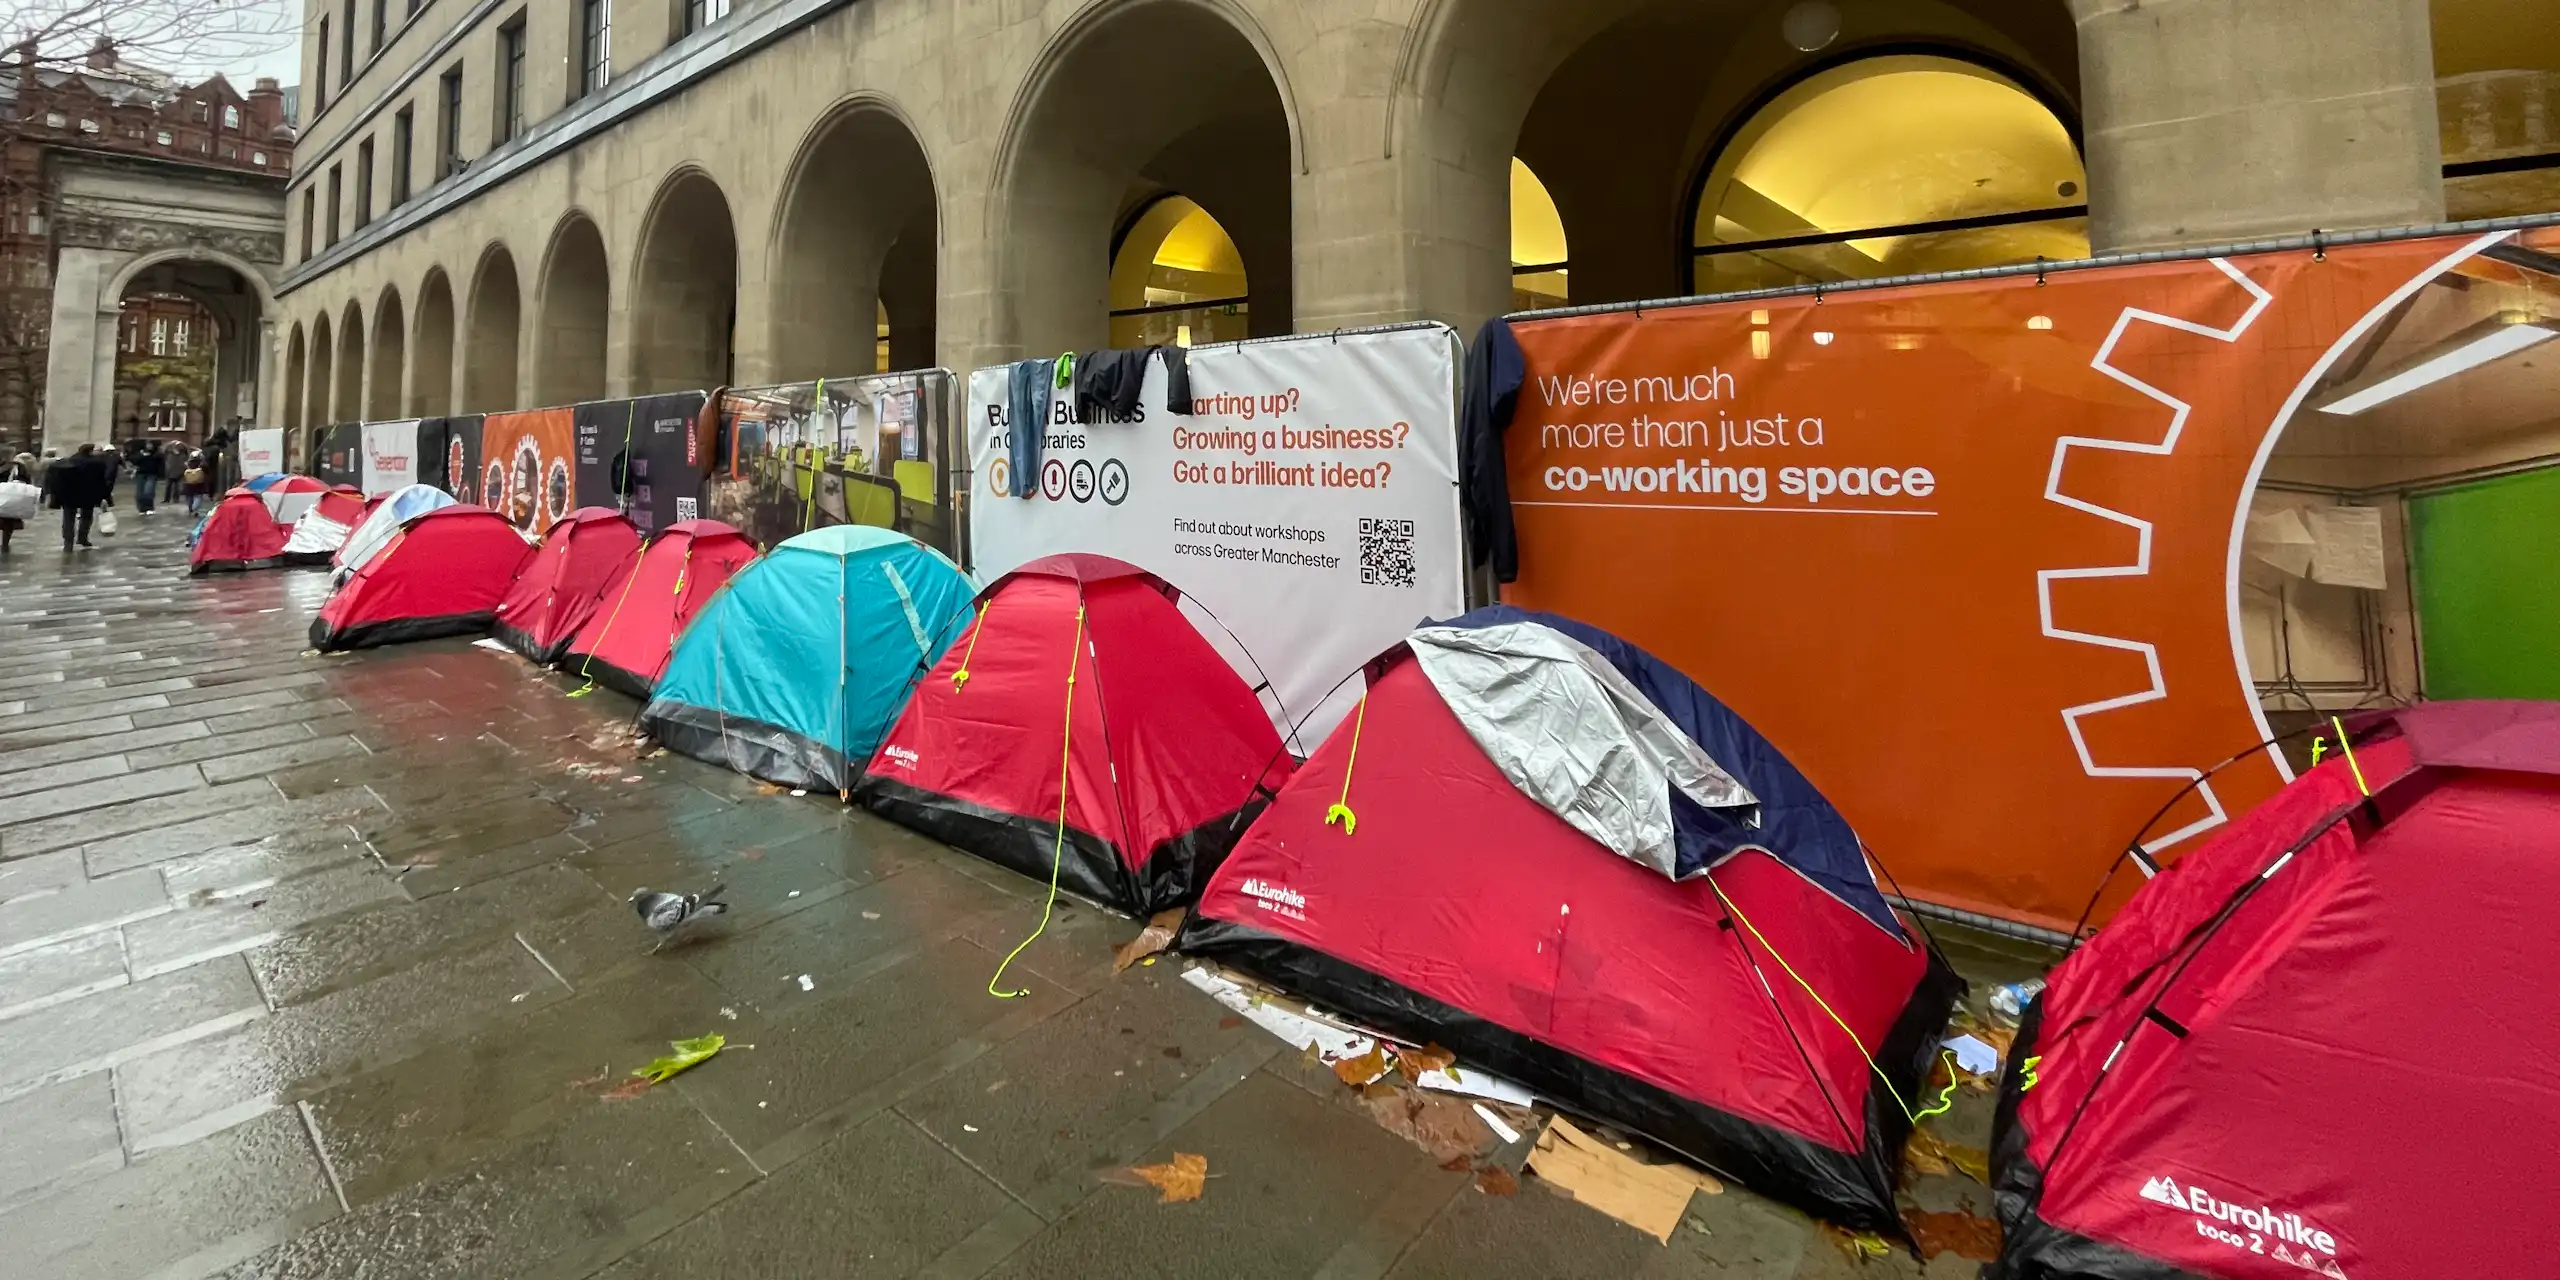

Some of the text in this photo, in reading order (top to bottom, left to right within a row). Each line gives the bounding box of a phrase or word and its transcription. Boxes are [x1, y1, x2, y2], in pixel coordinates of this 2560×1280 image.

[1260, 387, 1300, 418] up?
[1537, 366, 1735, 406] We're much
[990, 431, 1001, 449] in
[1172, 421, 1410, 456] Growing a business?
[1541, 411, 1824, 452] more than just a
[1173, 460, 1392, 489] Got a brilliant idea?
[1544, 459, 1936, 503] co-working space
[1174, 518, 1325, 545] Find out about workshops
[1174, 544, 1340, 569] across Greater Manchester
[1260, 881, 1306, 908] Eurohike
[2188, 1185, 2337, 1256] Eurohike
[2195, 1218, 2265, 1255] toco 2
